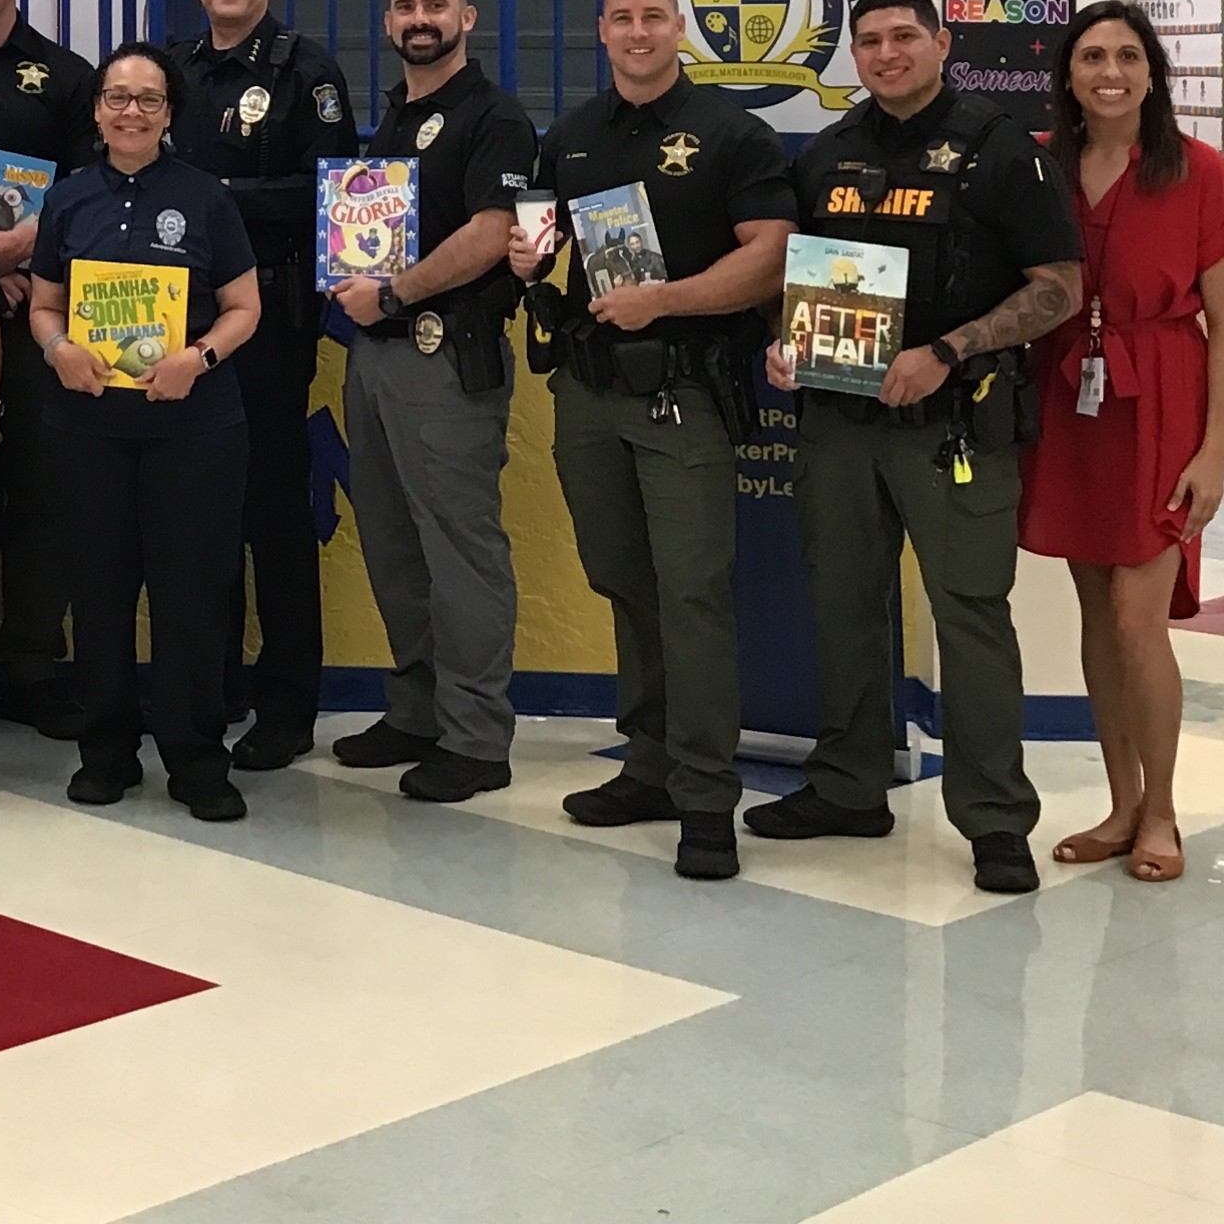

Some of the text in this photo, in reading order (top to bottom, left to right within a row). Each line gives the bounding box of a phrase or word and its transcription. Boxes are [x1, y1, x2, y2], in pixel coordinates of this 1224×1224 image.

[949, 61, 1053, 93] Someon
[331, 196, 407, 226] GLORIA
[827, 186, 934, 217] SHRIFF
[606, 214, 640, 229] Police
[82, 277, 160, 301] PIRANHAS
[90, 296, 157, 327] DON'T
[790, 301, 892, 343] AFTER
[88, 323, 166, 343] EAT BANANAS
[810, 333, 889, 371] FALL
